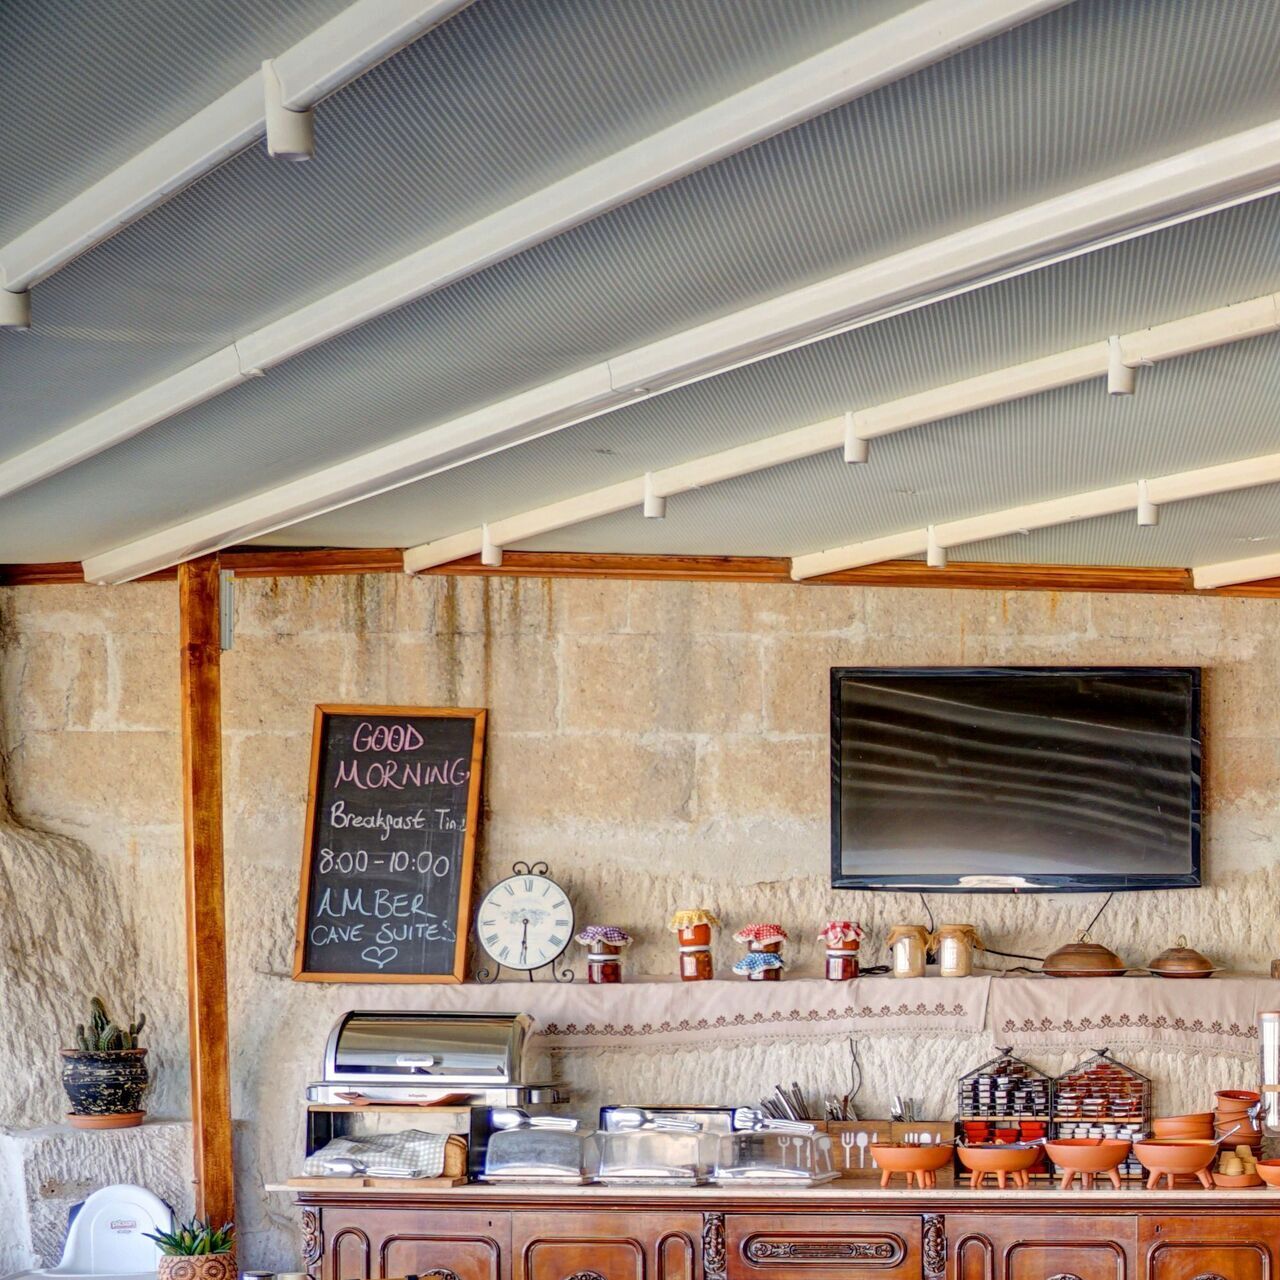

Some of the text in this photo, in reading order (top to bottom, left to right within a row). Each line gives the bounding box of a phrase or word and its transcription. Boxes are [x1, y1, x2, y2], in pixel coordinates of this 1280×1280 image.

[353, 722, 424, 753] GOOD
[334, 757, 470, 790] MORNING
[330, 800, 426, 841] Breakfast
[316, 887, 438, 919] AMBER
[311, 920, 456, 946] CAVE SUITES
